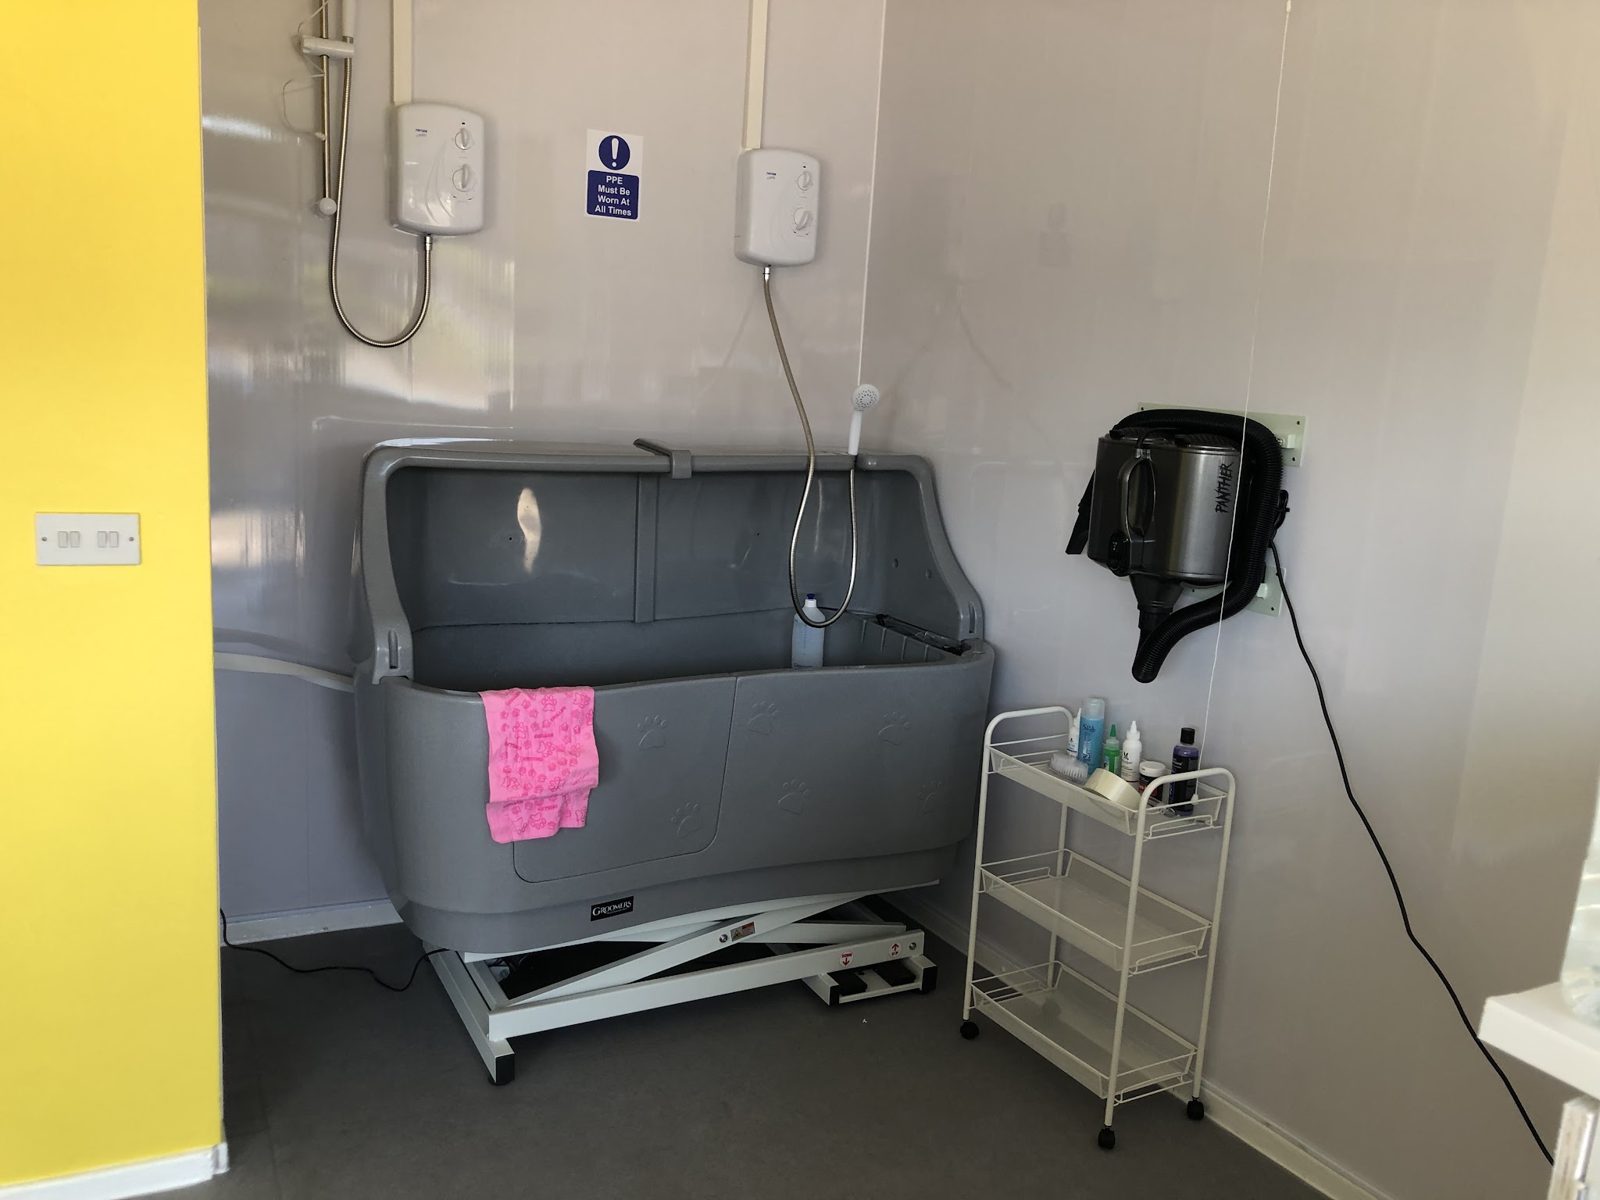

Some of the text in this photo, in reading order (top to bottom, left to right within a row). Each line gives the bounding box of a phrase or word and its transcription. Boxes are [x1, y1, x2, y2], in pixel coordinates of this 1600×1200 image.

[606, 175, 623, 185] PPE
[597, 184, 631, 196] Must Be
[597, 194, 630, 206] Worn At
[594, 204, 632, 216] All Times
[1214, 461, 1234, 513] PANTHER
